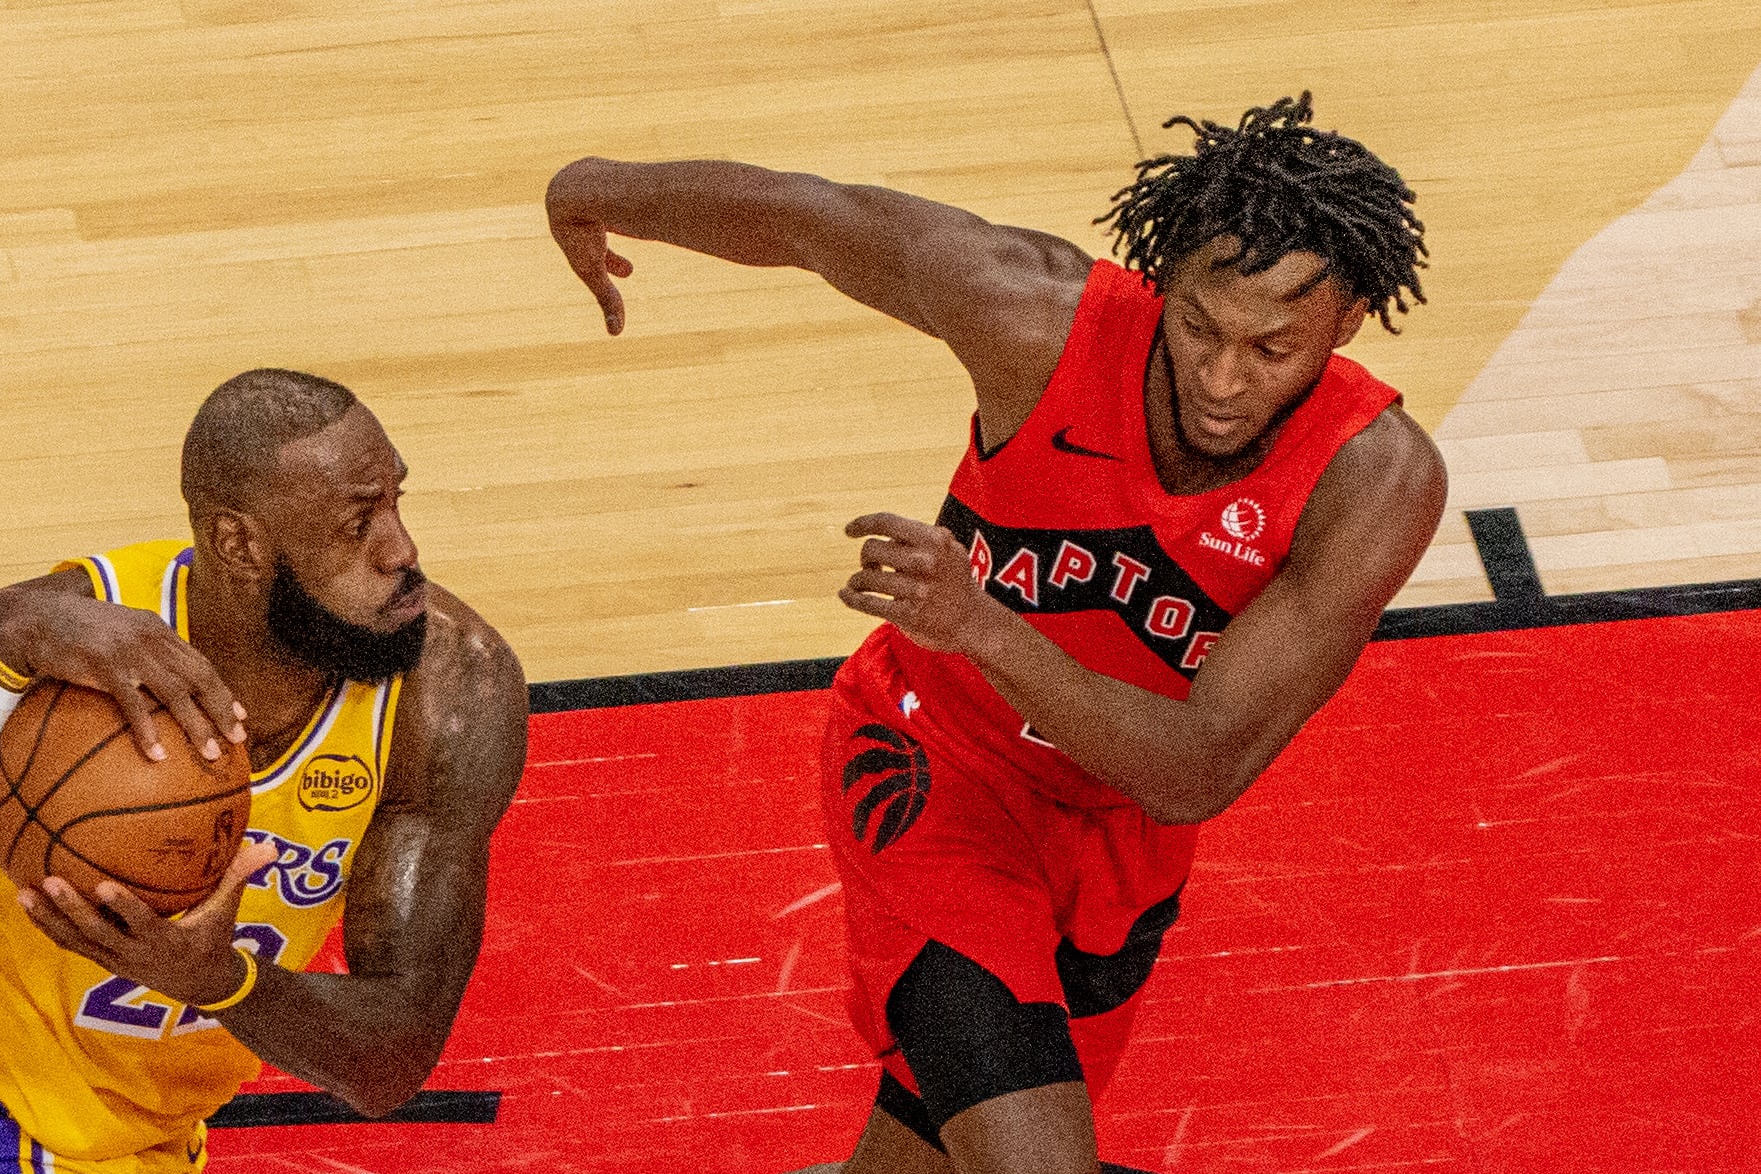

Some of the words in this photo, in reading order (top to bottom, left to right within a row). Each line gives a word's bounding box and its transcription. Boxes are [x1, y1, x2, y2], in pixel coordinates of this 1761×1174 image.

[1199, 532, 1232, 554] Sun
[1233, 543, 1265, 567] Life
[302, 769, 368, 795] bibigo
